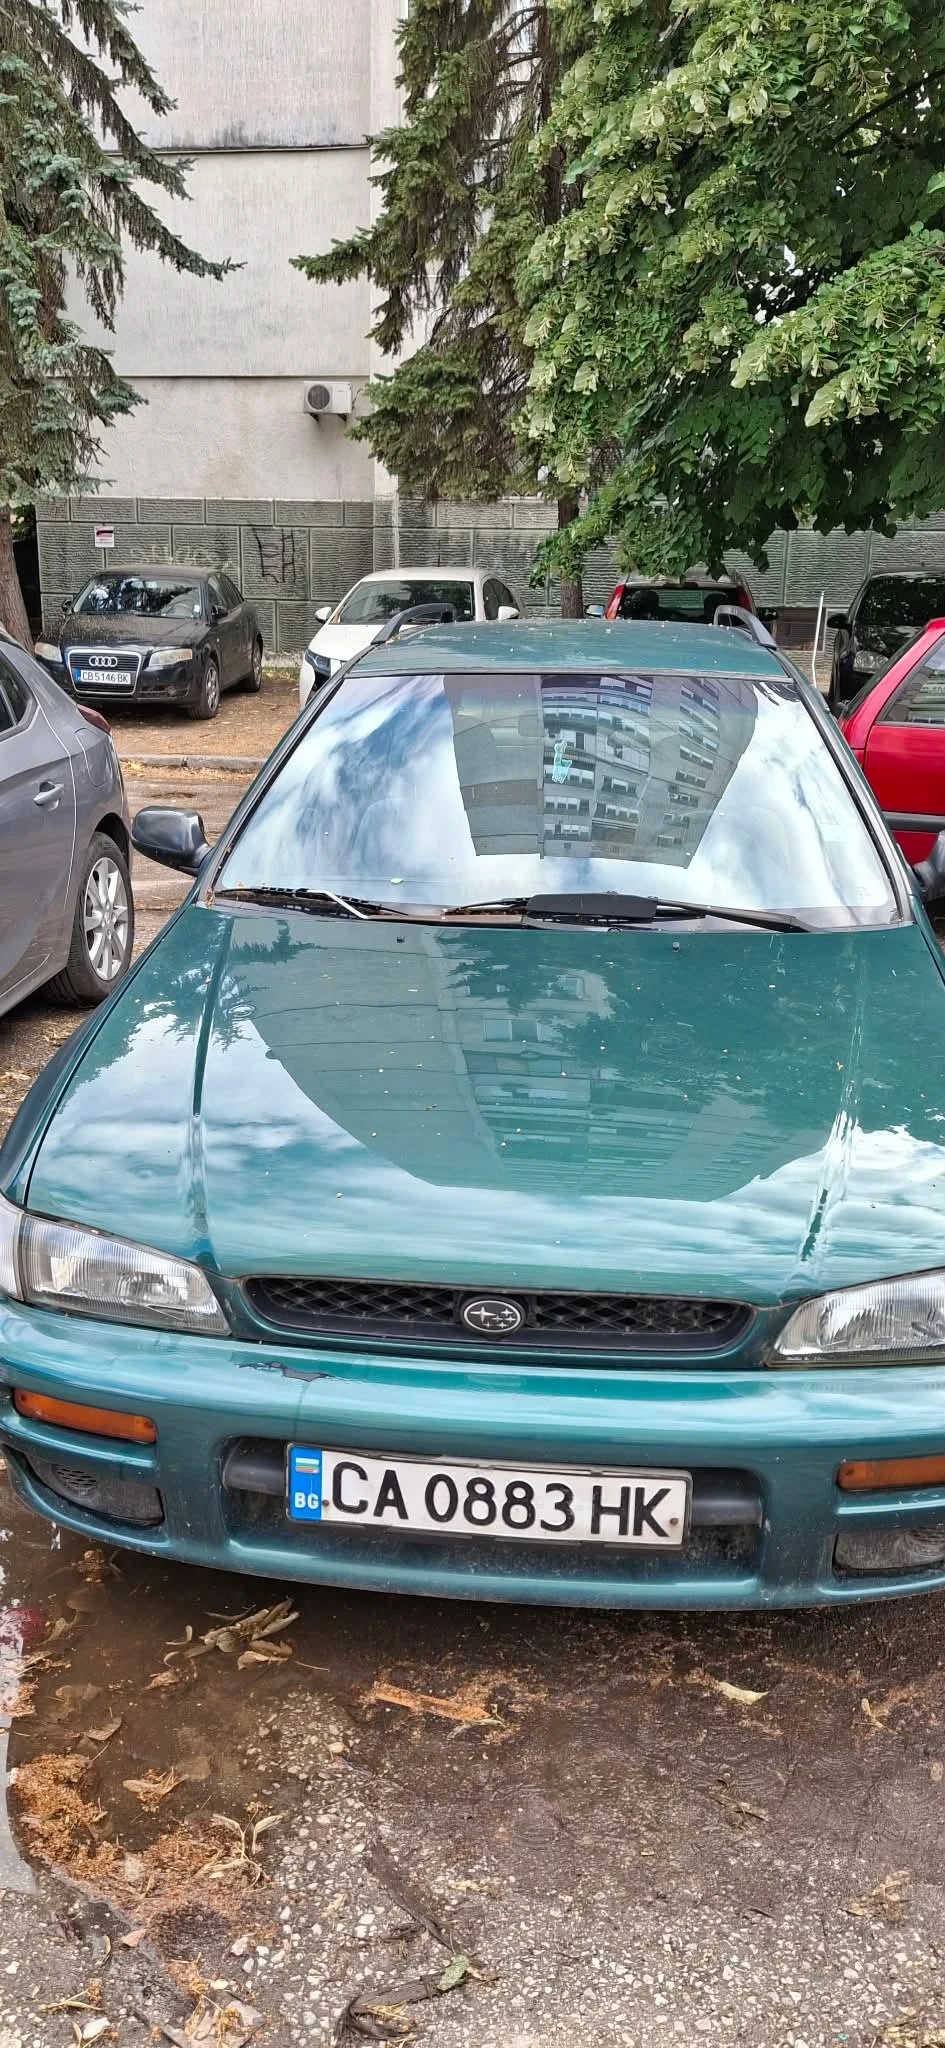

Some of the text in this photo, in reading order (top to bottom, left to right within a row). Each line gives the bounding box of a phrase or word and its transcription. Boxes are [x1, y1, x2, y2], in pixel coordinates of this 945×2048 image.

[82, 671, 93, 681] CB
[95, 672, 116, 683] 5146
[294, 1491, 319, 1510] BG
[332, 1461, 671, 1538] CA 0883 HK
